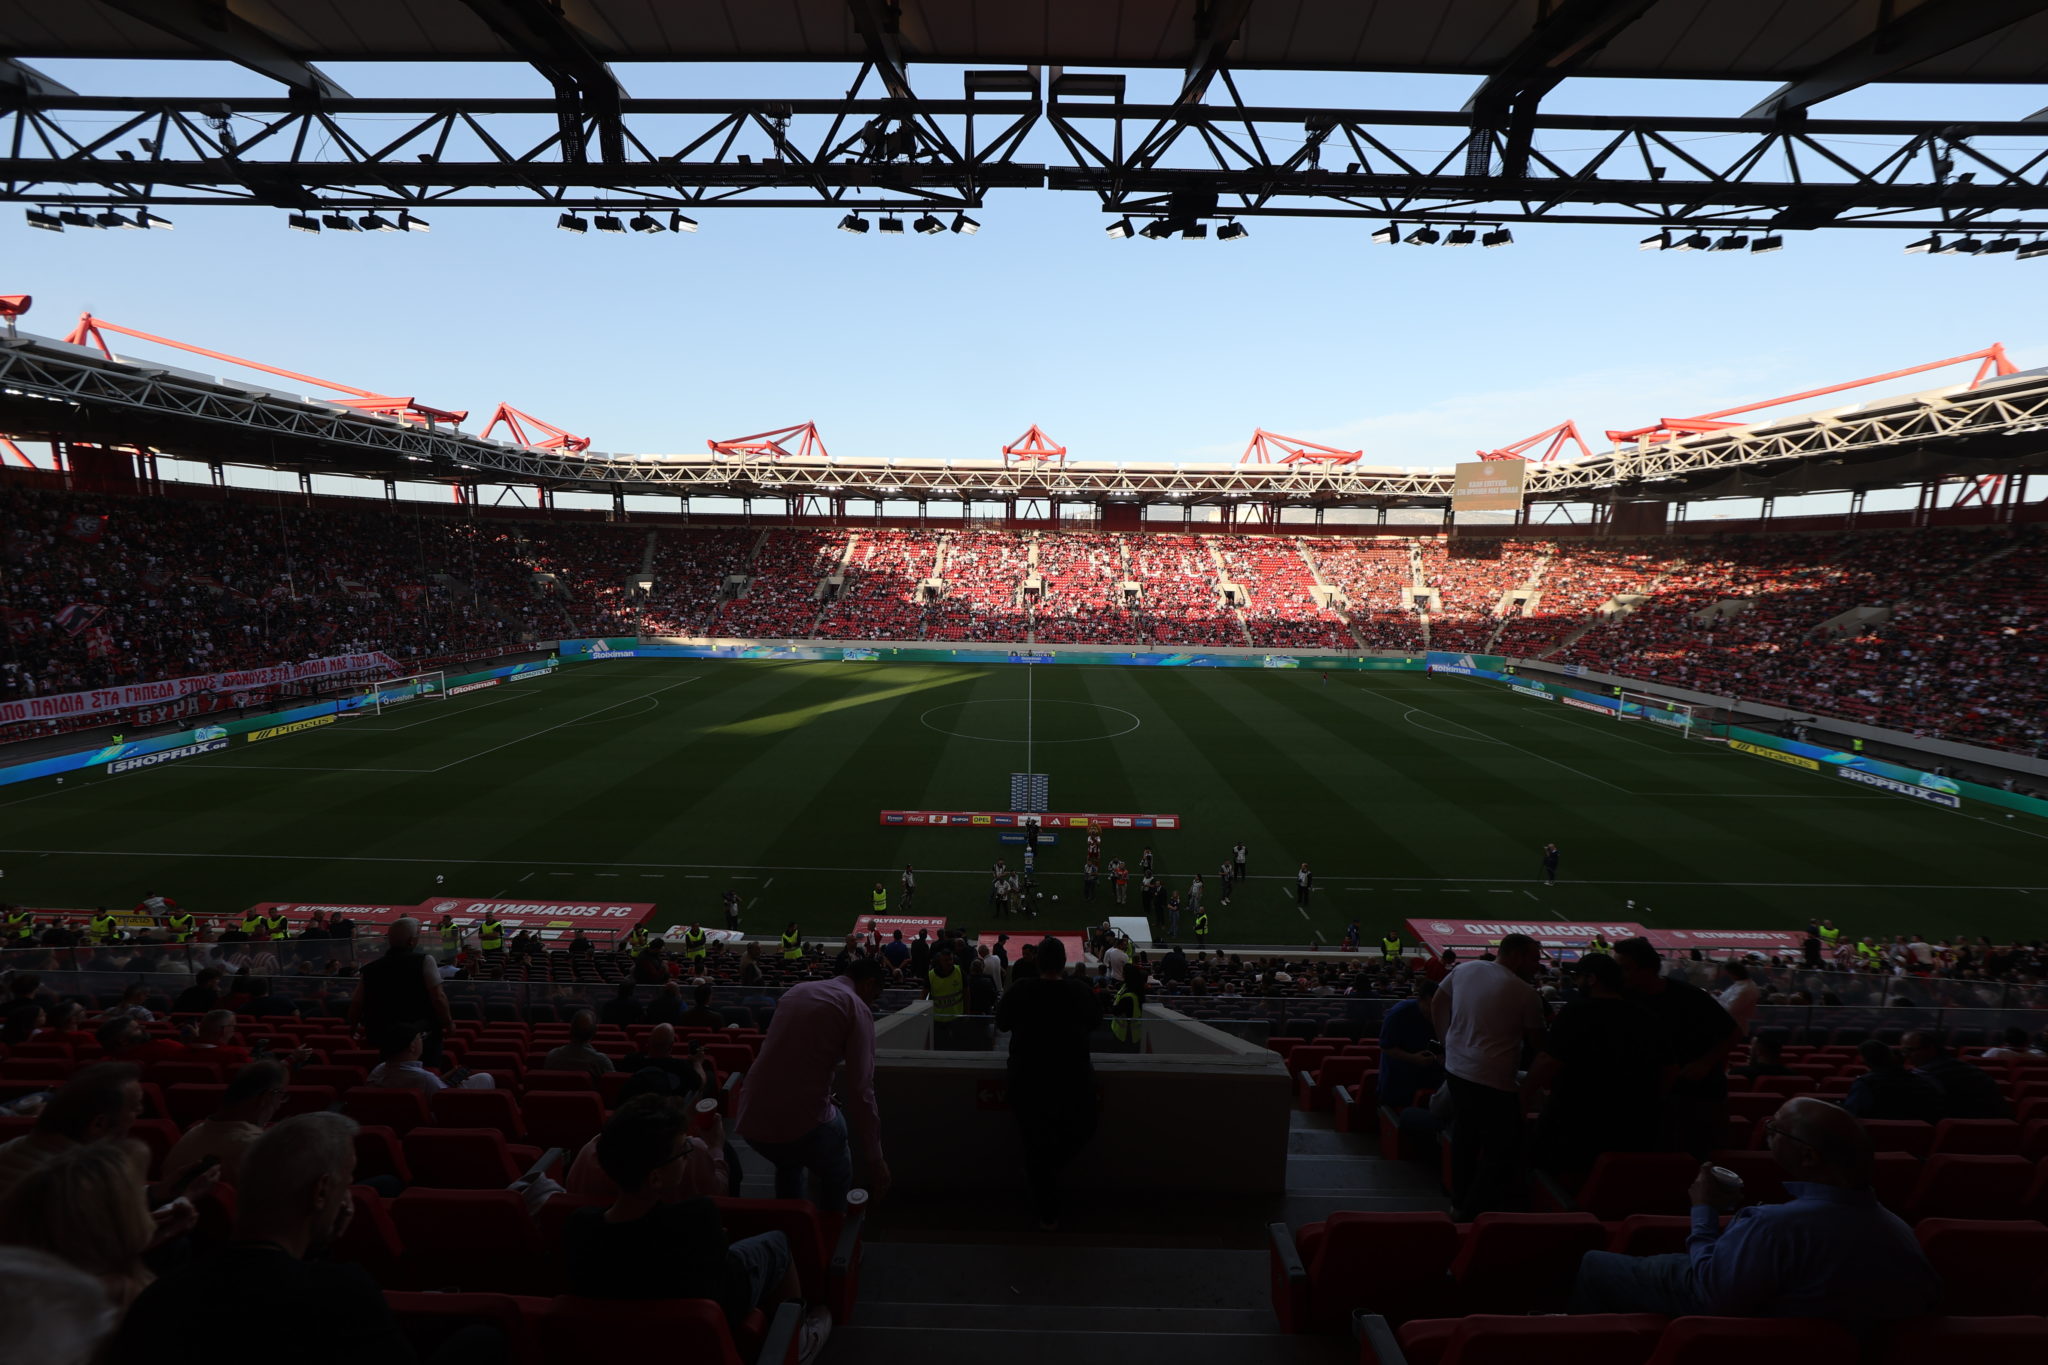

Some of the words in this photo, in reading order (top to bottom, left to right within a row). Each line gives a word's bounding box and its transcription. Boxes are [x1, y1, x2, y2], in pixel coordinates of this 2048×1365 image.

[31, 695, 84, 717] ΠΑΙΔΙΑ
[92, 691, 119, 708] ΣΤΑ
[125, 682, 174, 703] ΓΗΠΕΔΑ
[179, 676, 216, 695] ΣΤΟΥΣ
[275, 717, 329, 734] Piraeus
[293, 905, 372, 914] OLYMPIACOS
[465, 903, 600, 917] OLYMPIACOS
[601, 906, 632, 917] FC
[1463, 924, 1602, 936] OLYMPIACOS
[1601, 926, 1635, 937] FC
